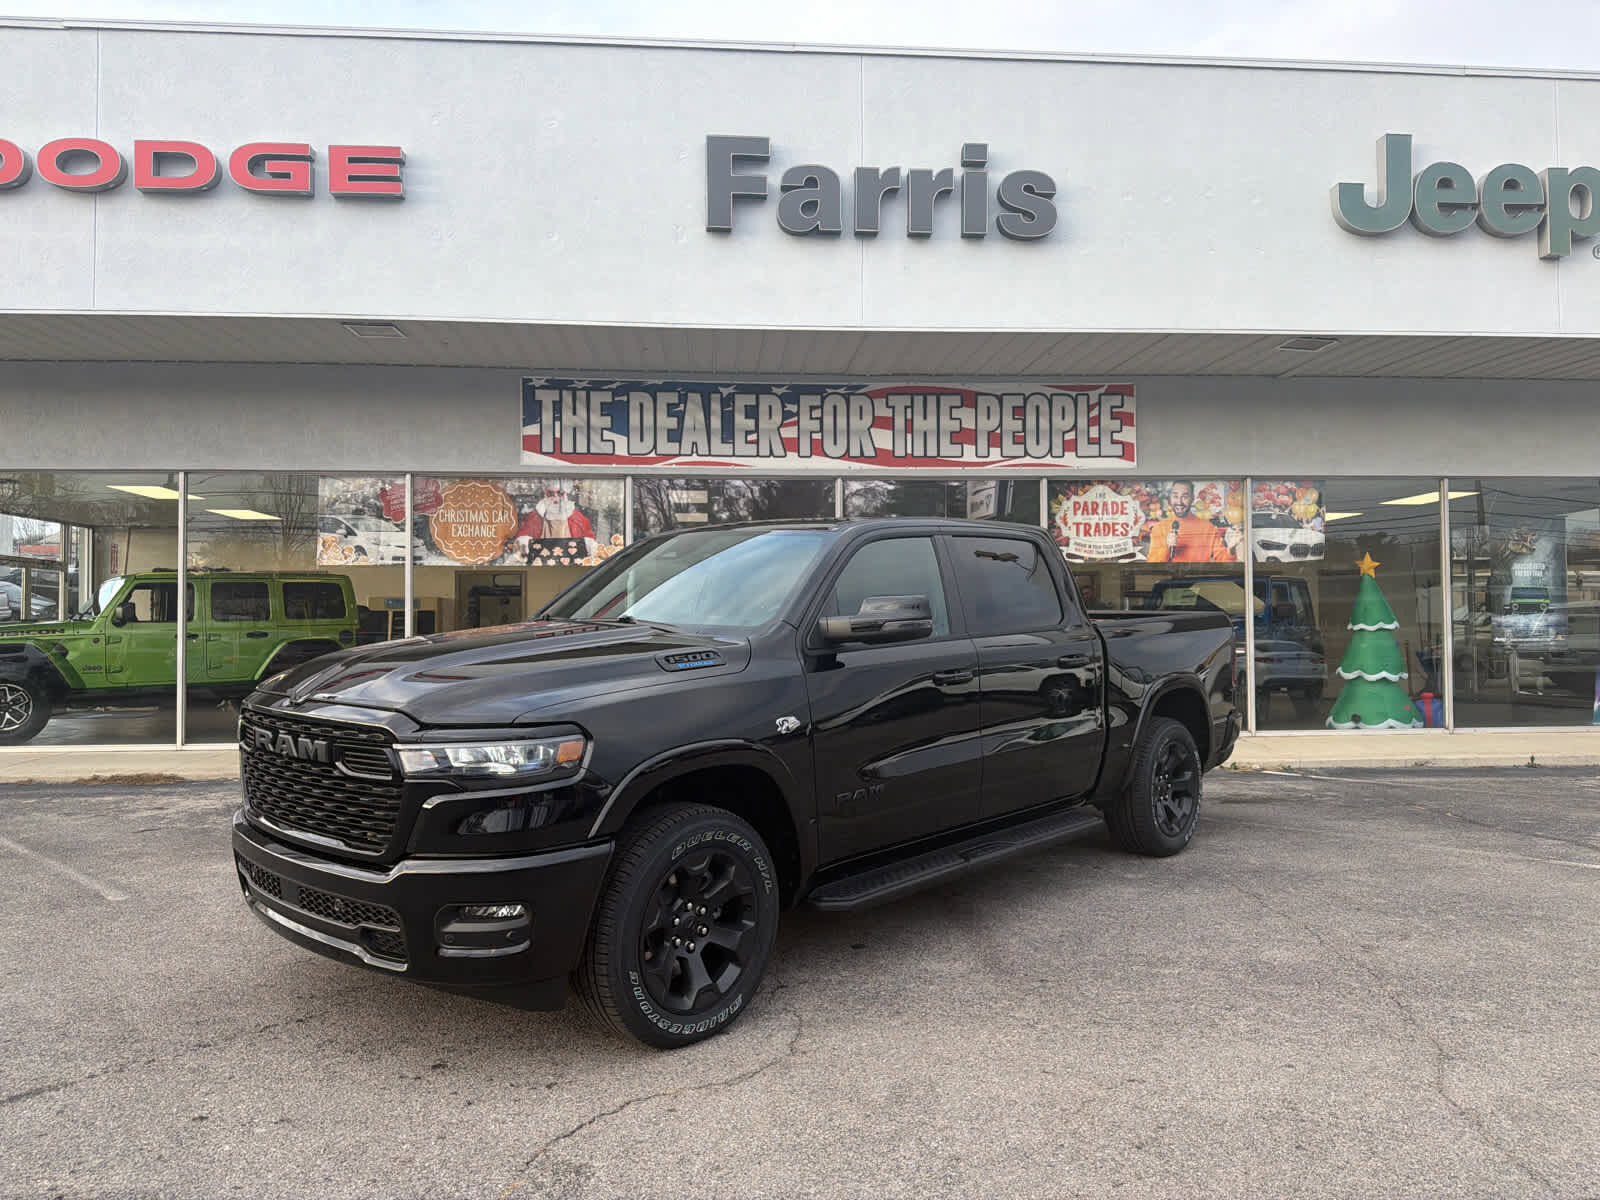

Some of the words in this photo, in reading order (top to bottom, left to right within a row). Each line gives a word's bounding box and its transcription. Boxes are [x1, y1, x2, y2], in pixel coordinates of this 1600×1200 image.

[705, 134, 1058, 239] Farris
[1331, 133, 1600, 259] Jeep
[535, 389, 616, 455] THE
[627, 390, 788, 458] DEALER
[797, 391, 878, 459] FOR
[886, 392, 964, 459] THE
[975, 392, 1125, 459] PEOPLE
[439, 508, 488, 523] CHRISTMAS
[491, 508, 511, 523] CAR
[1072, 501, 1129, 516] PARADE
[451, 523, 498, 538] EXCHANGE
[1072, 522, 1130, 537] TRADES
[666, 652, 715, 664] 1500
[254, 726, 328, 762] RAM
[832, 784, 884, 809] RAM
[672, 830, 752, 860] DUELER
[629, 970, 744, 1035] BRIDGESTONE
